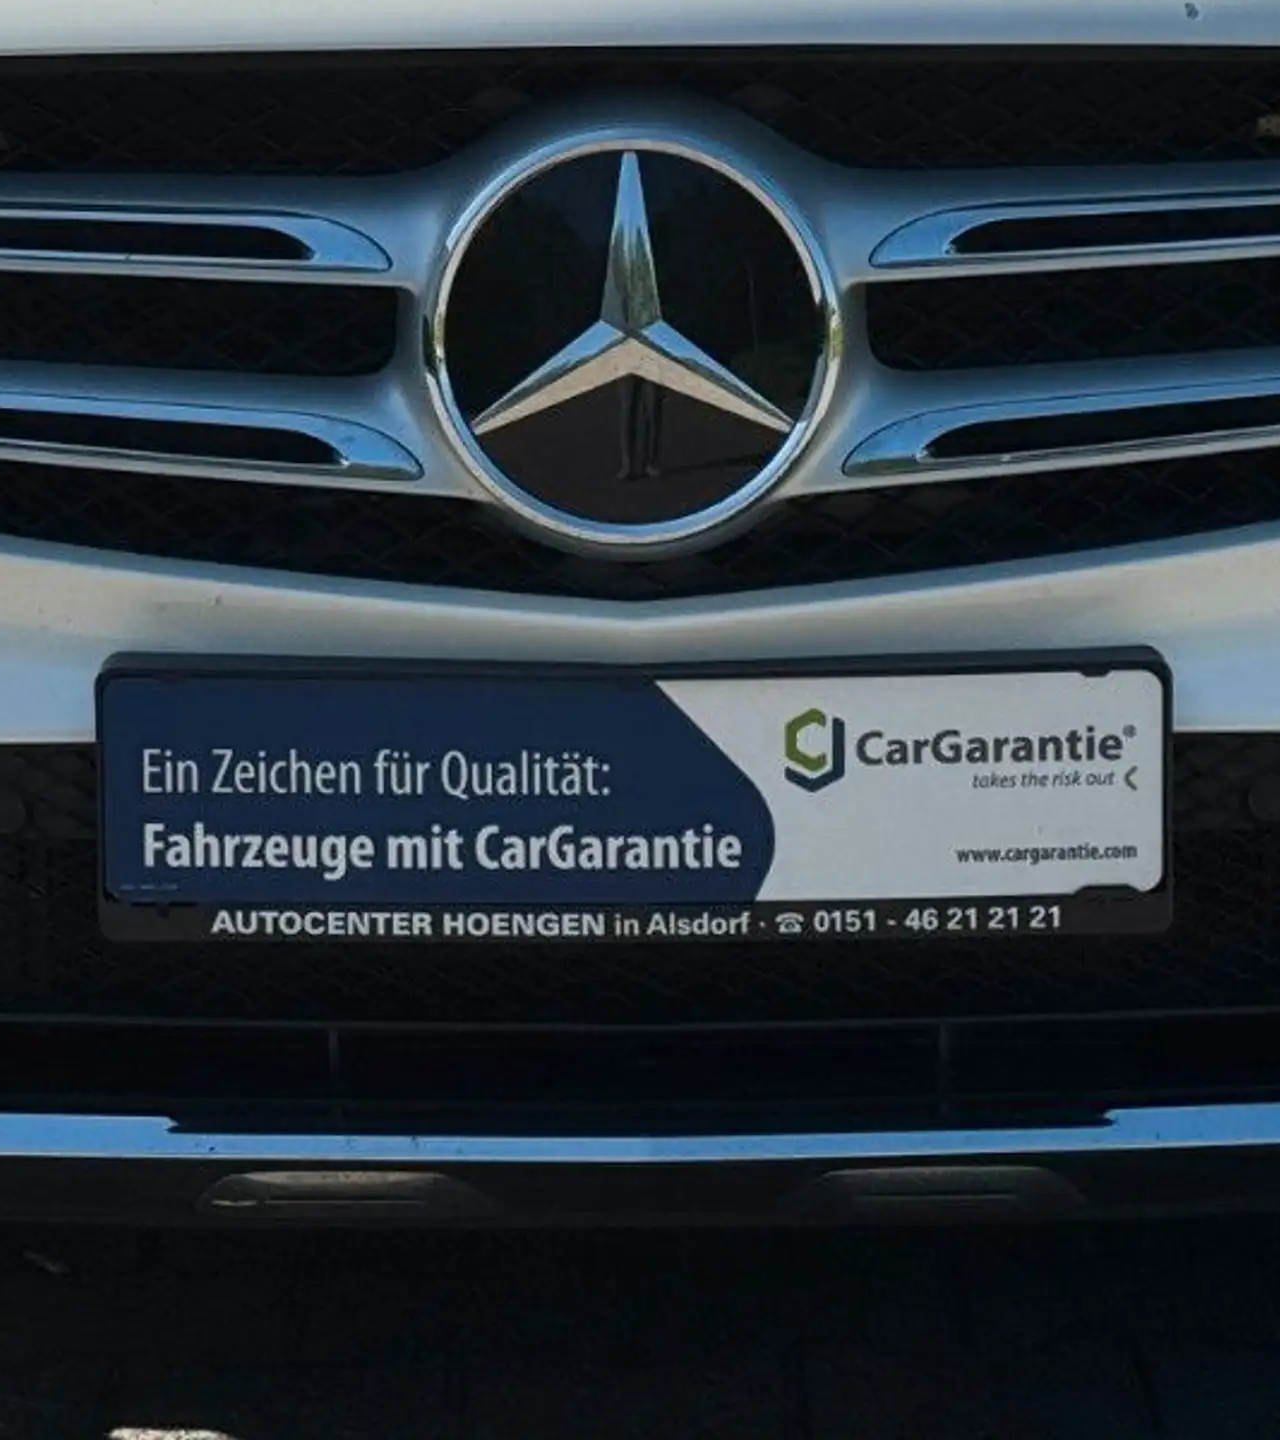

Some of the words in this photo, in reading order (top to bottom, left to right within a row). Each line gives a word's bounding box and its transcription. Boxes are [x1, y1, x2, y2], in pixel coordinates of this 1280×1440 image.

[143, 748, 199, 794] Ein
[211, 748, 361, 795] Zeichen
[373, 748, 431, 795] für
[441, 750, 610, 800] Qualität:
[972, 771, 1017, 789] takes
[1020, 770, 1050, 788] the
[1051, 769, 1081, 787] risk
[1085, 770, 1116, 786] out
[144, 821, 375, 881] Fahrzeuge
[387, 823, 464, 870] mit
[475, 823, 742, 870] CarGarantie
[956, 842, 1138, 865] www.cargarantie.com
[211, 909, 433, 936] AUTOCENTER
[443, 912, 605, 937] HOENGEN
[614, 913, 640, 936] in
[646, 911, 751, 936] Alsdorf
[813, 908, 876, 933] 0151
[904, 907, 939, 931] 46
[947, 907, 977, 931] 21
[988, 906, 1018, 930] 21
[1029, 905, 1060, 929] 21
